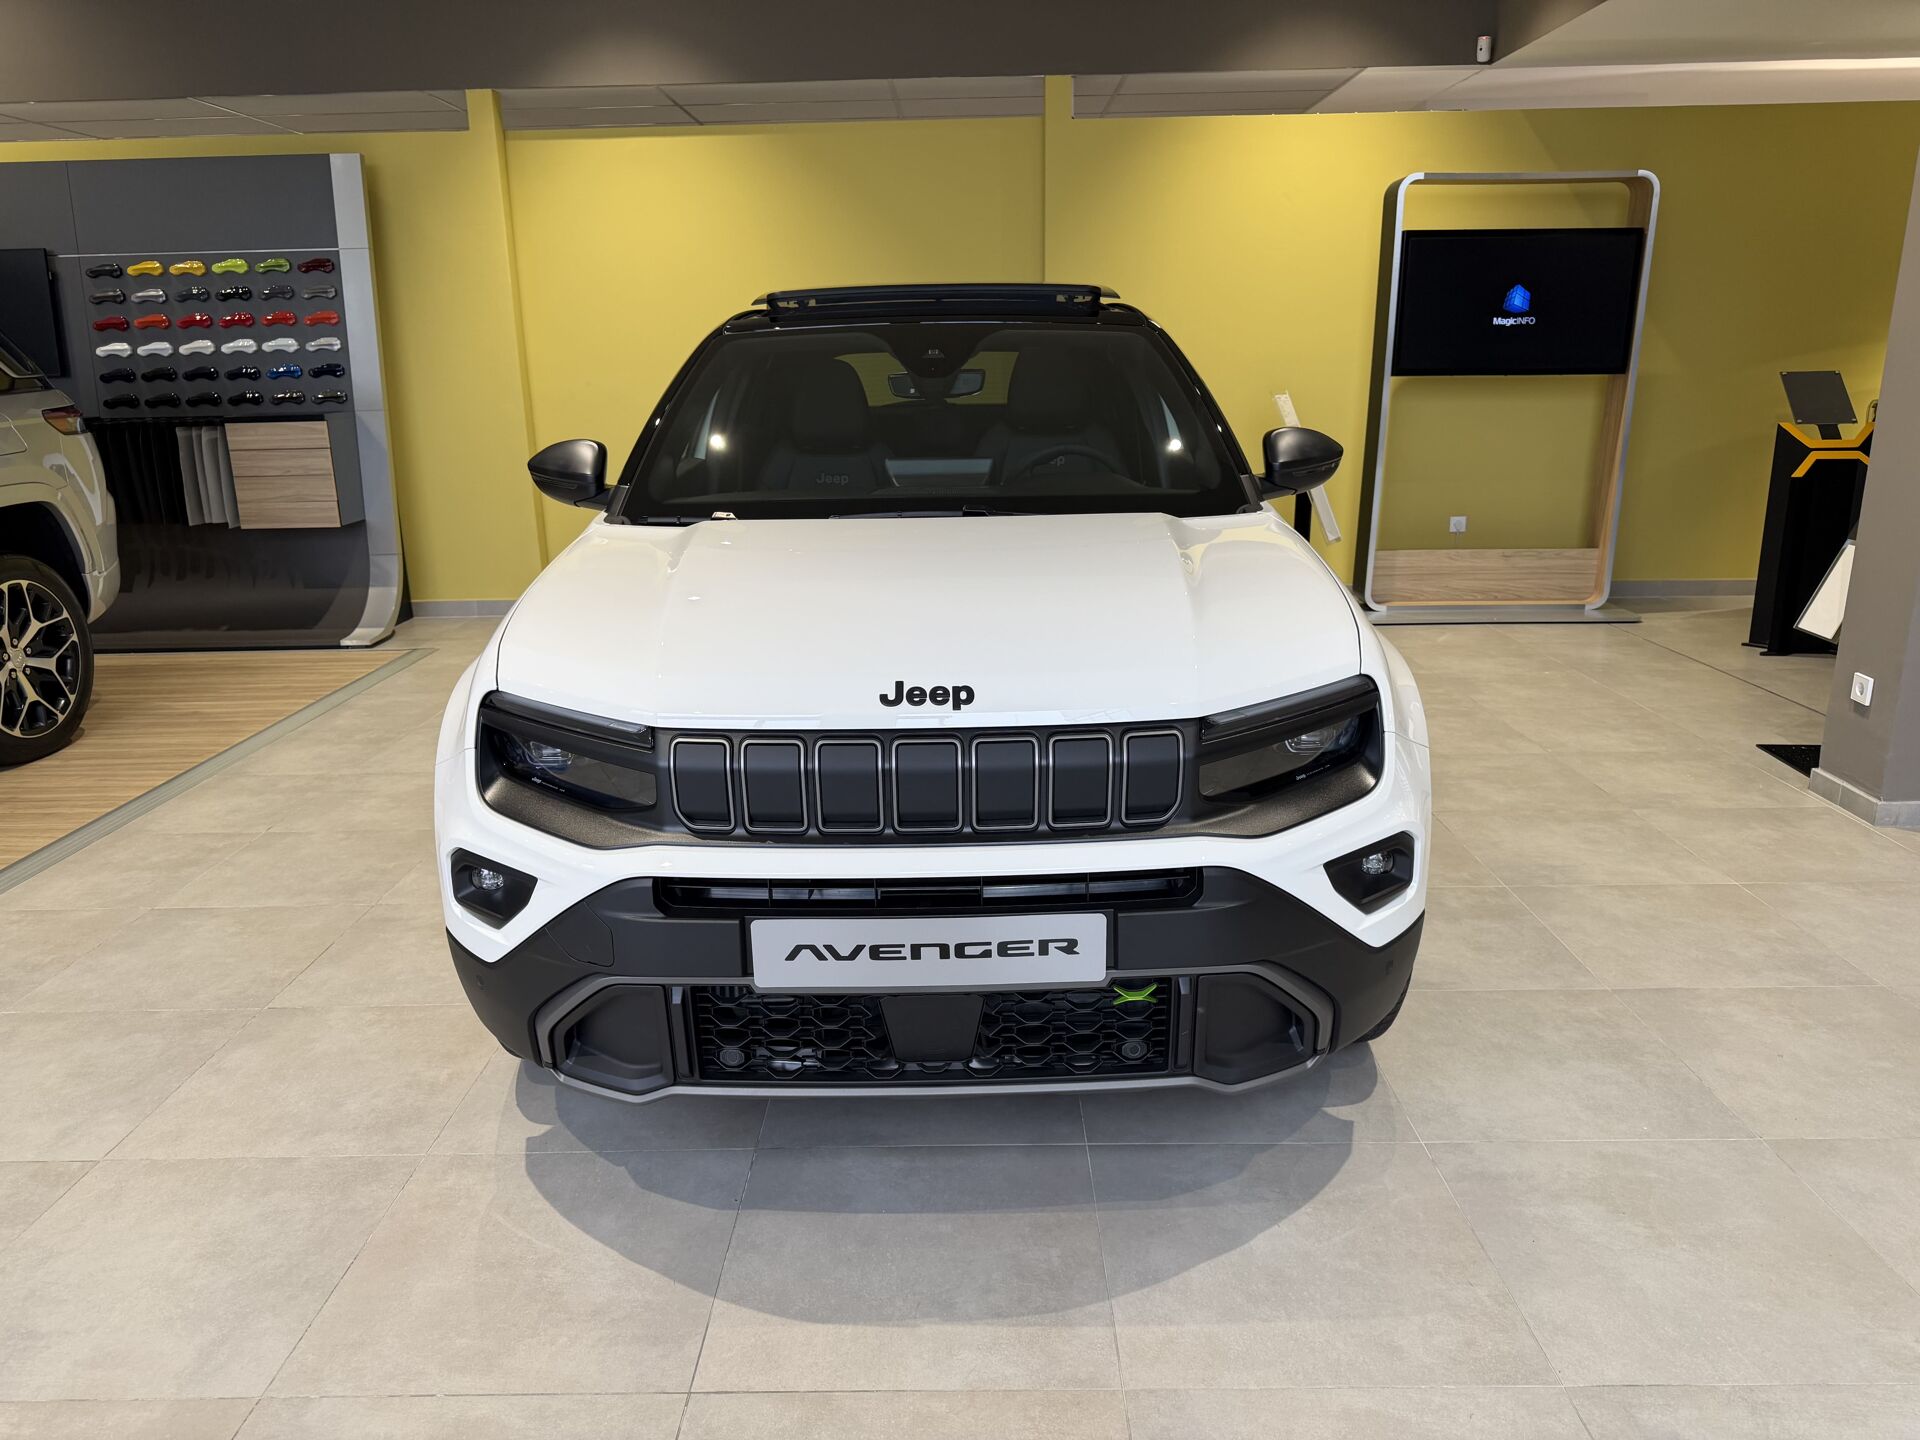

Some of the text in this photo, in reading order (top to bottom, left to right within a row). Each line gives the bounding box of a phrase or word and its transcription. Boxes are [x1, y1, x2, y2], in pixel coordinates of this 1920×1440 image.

[1492, 316, 1536, 327] MagicINFO
[815, 472, 849, 486] Jeep
[879, 680, 975, 711] Jeep
[784, 938, 1081, 962] AVENGER
